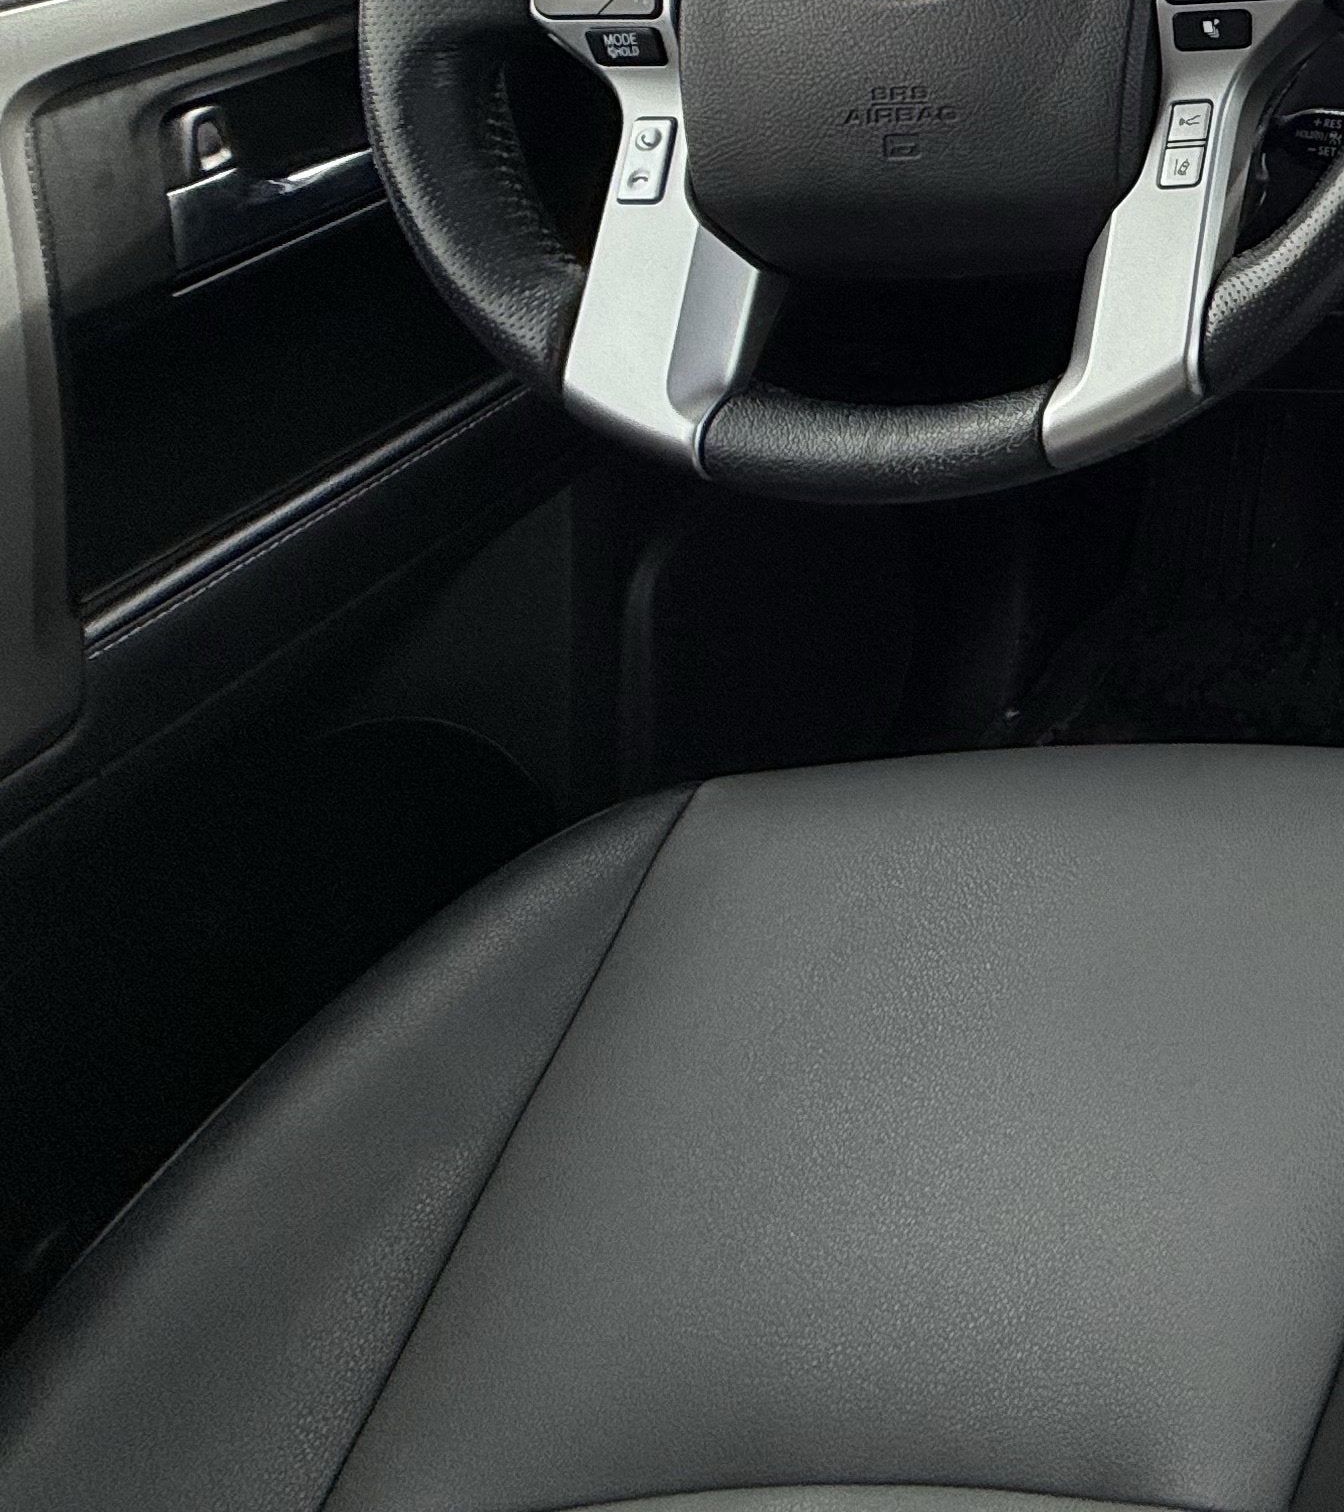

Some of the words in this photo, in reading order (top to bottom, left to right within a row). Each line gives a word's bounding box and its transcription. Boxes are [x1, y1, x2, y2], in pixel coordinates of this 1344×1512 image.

[603, 32, 639, 46] MODE
[617, 46, 641, 58] HOLD
[871, 86, 929, 101] SRS
[843, 106, 958, 125] AIRBAG
